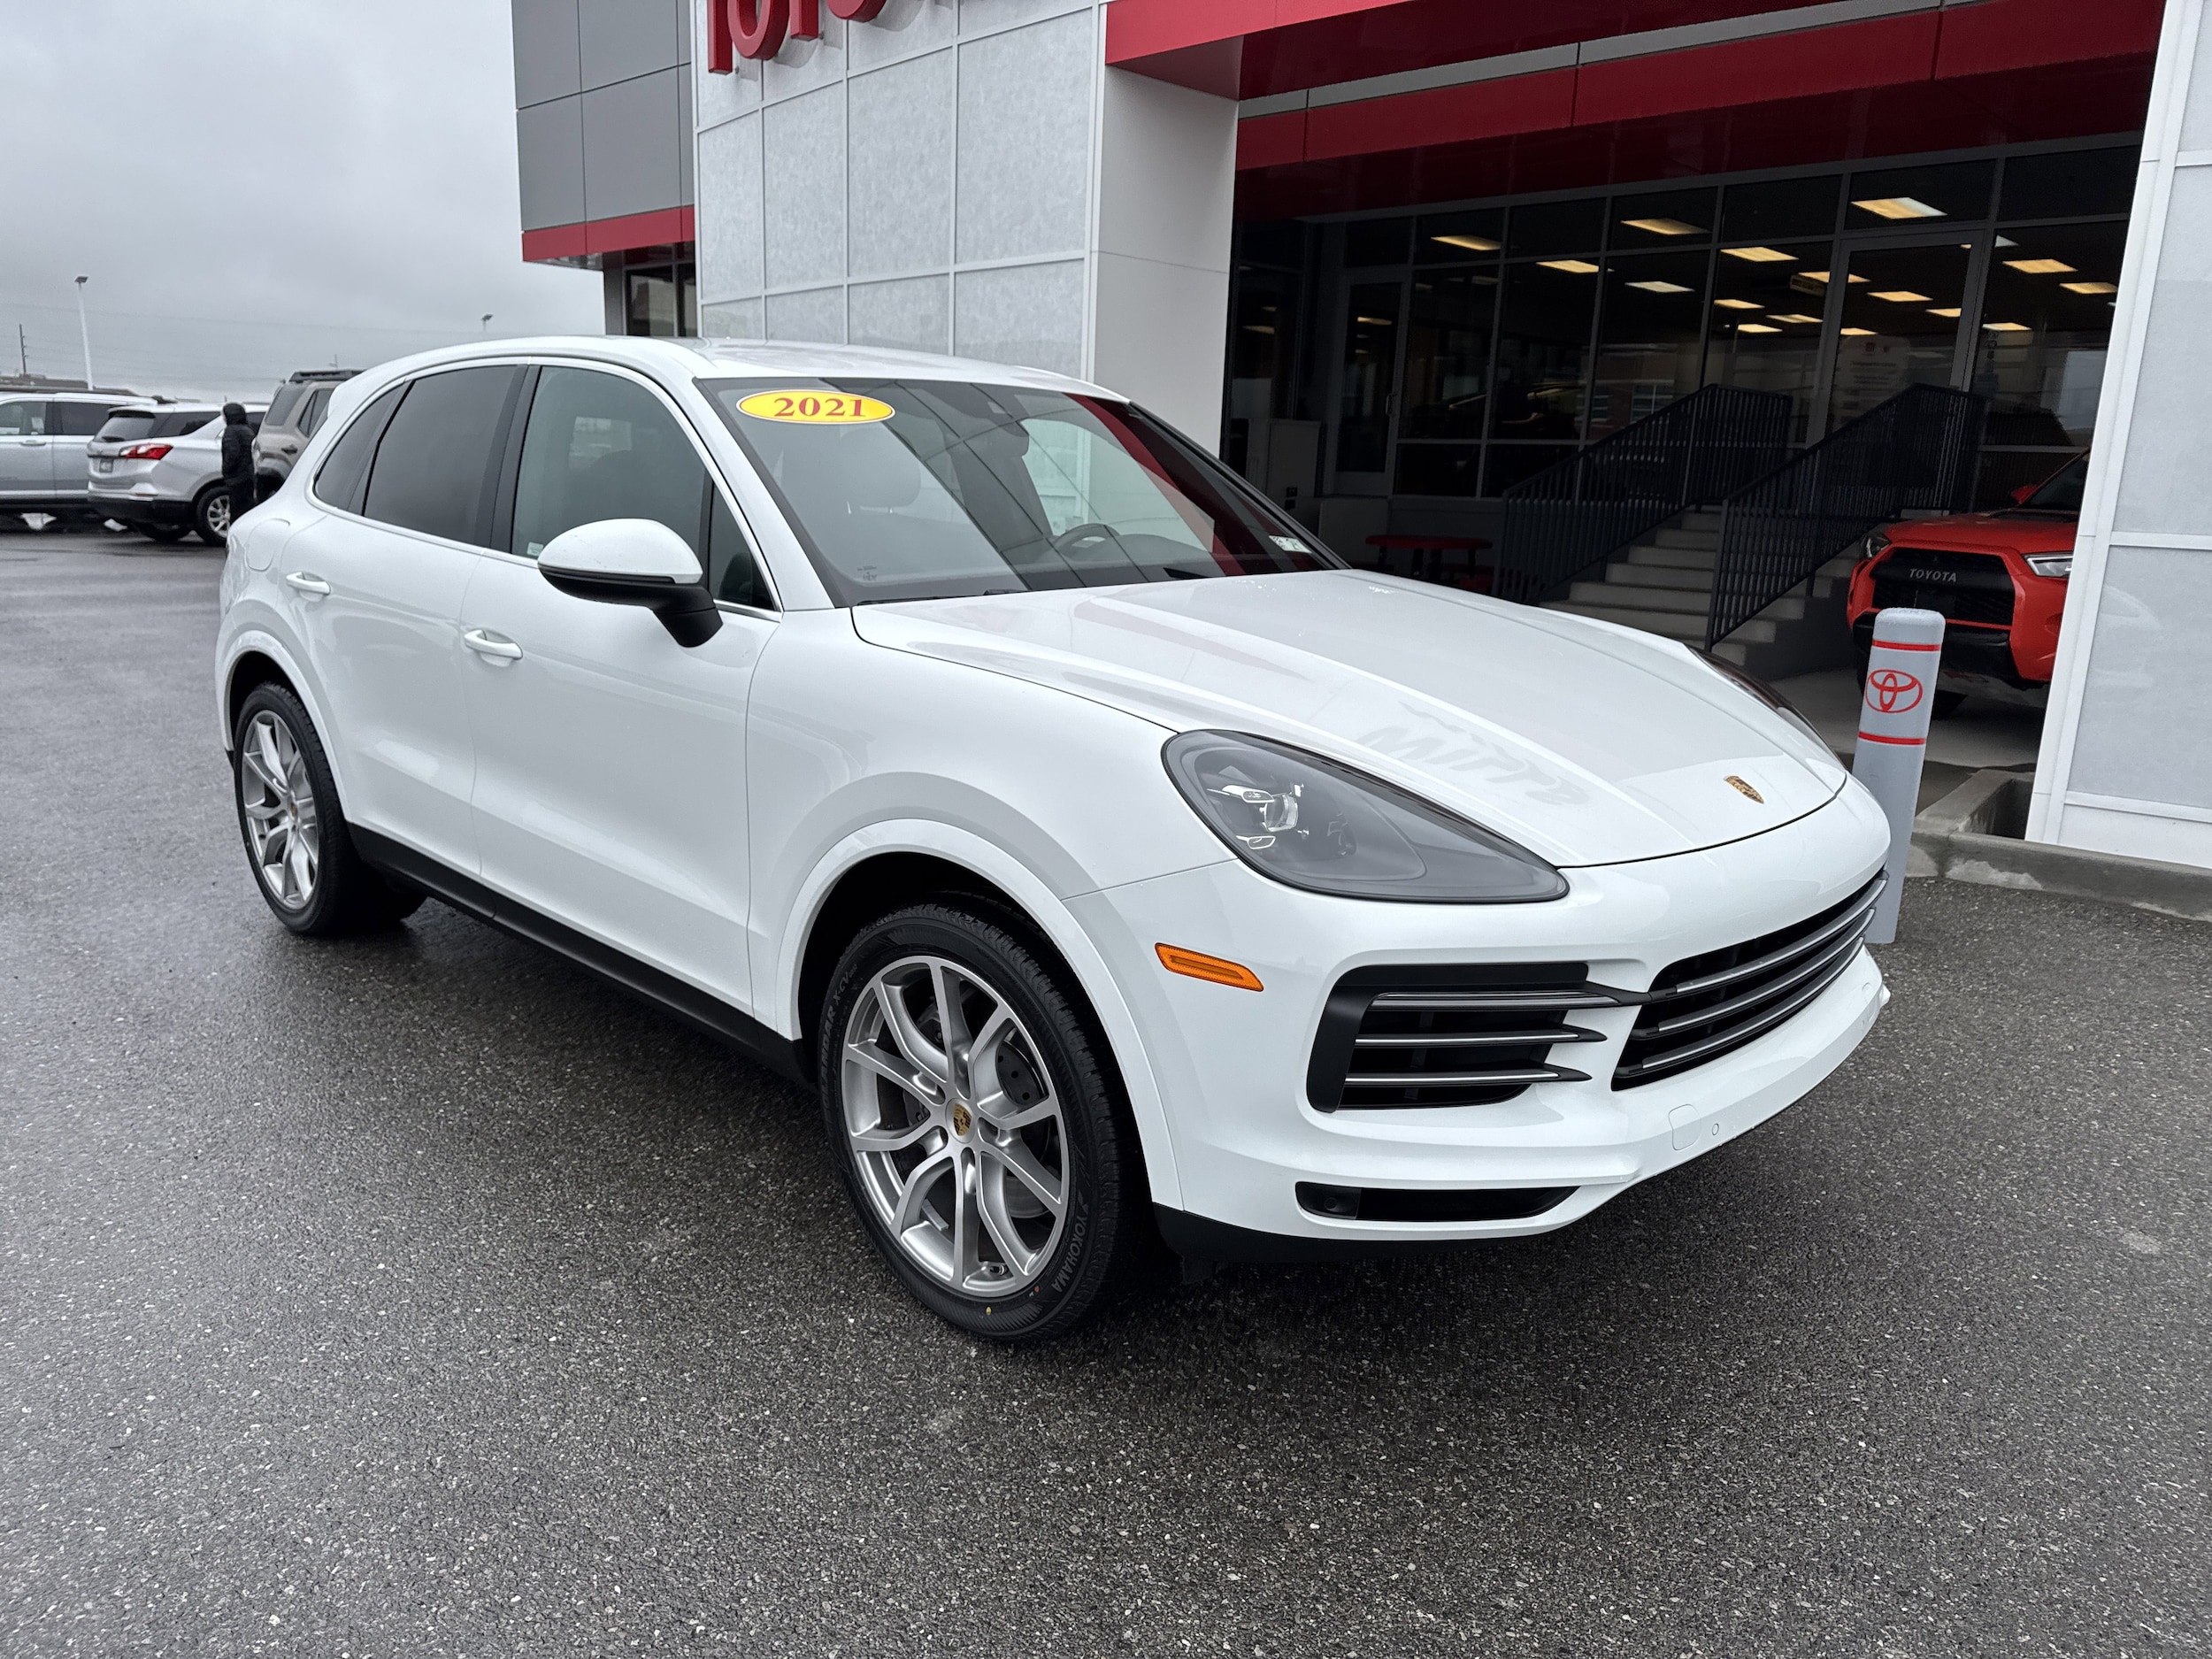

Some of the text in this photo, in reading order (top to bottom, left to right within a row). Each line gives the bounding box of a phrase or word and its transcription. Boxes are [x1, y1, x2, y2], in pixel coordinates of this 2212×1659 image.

[774, 397, 867, 418] 2021
[1909, 568, 1957, 582] TOYOTA
[1051, 1216, 1087, 1293] YOKOHAMA
